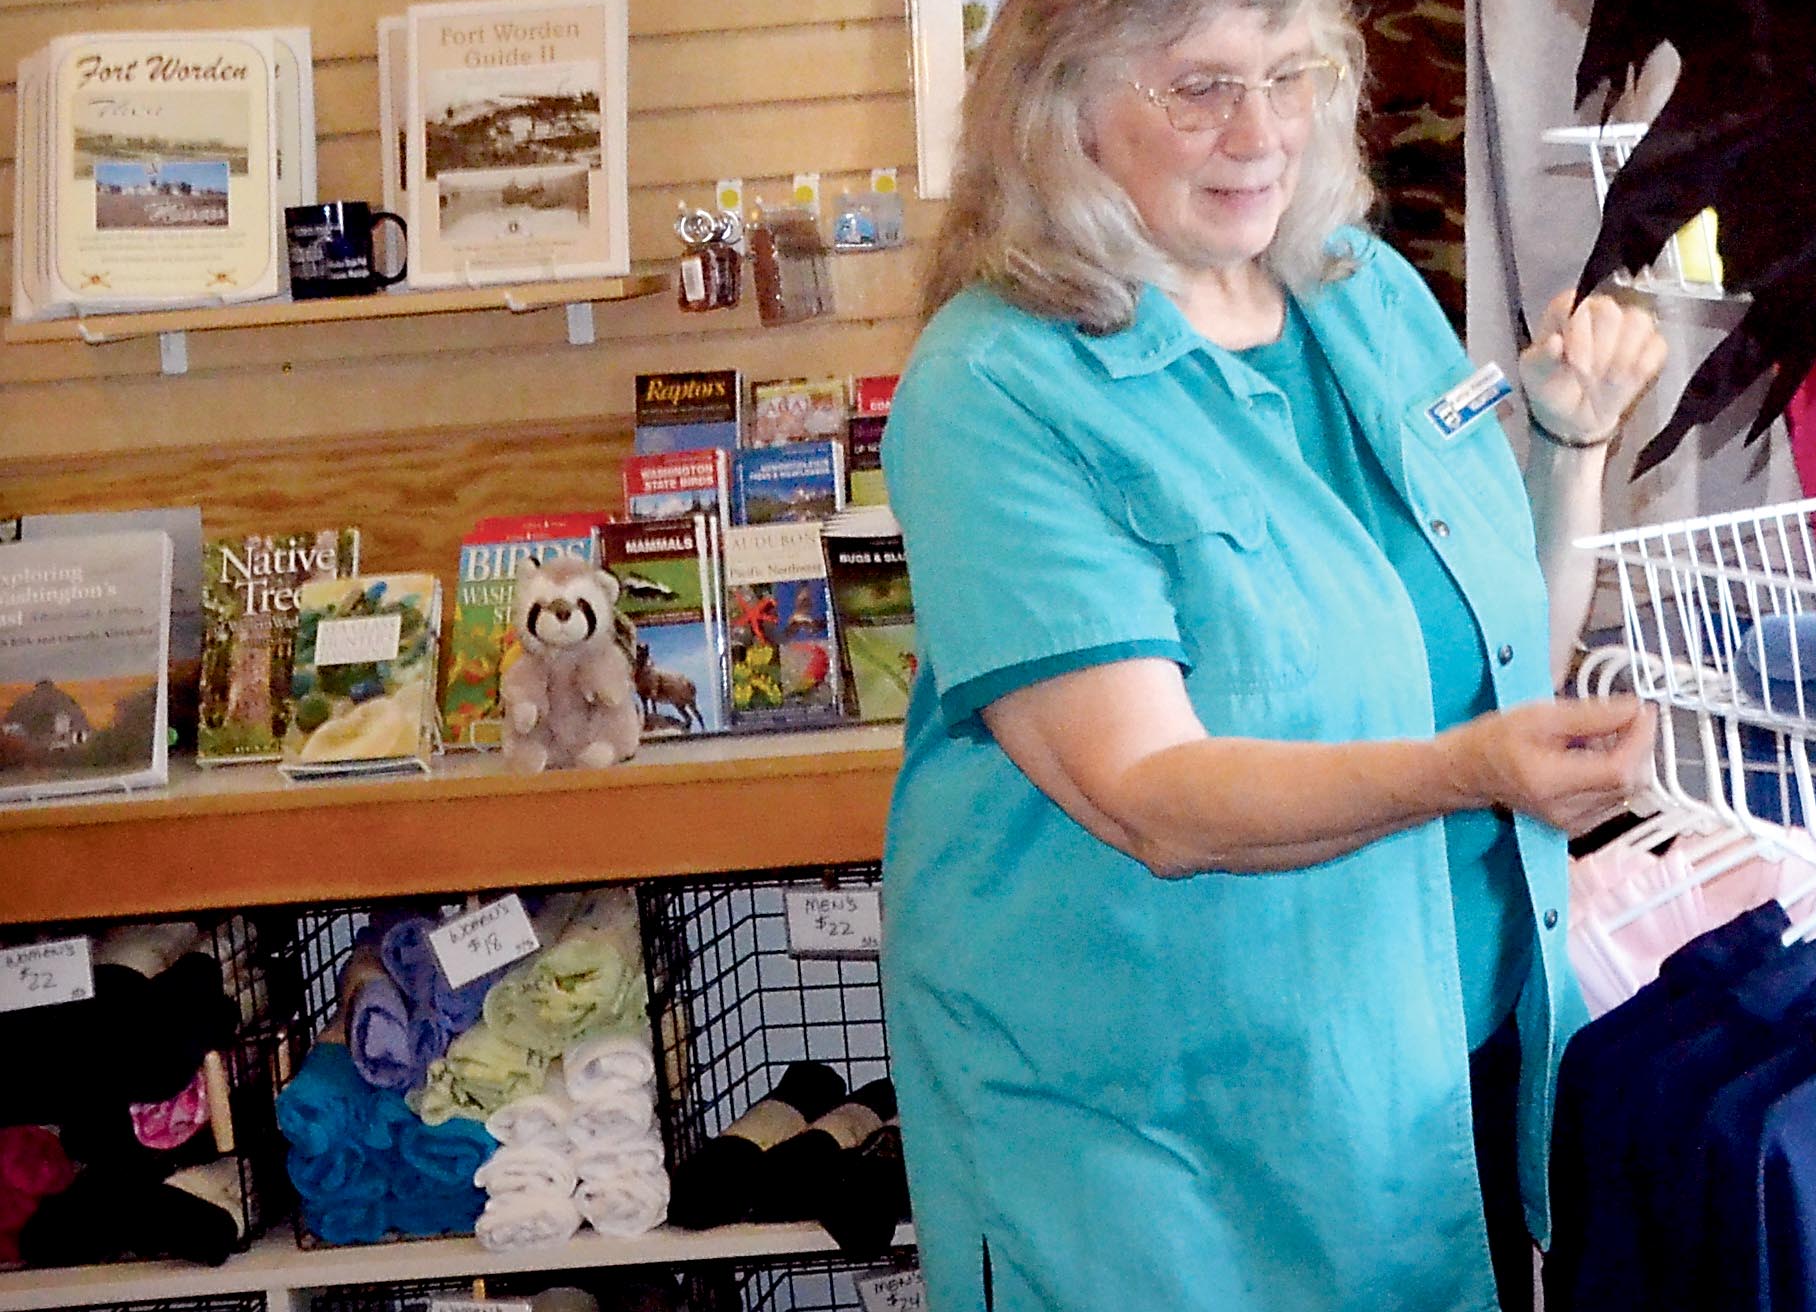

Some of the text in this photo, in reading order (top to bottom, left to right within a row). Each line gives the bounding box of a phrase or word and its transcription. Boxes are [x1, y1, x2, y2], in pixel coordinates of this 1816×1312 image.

[440, 21, 580, 46] Fort Worden
[464, 47, 532, 68] Guide
[75, 56, 248, 90] Fort Worden
[646, 376, 726, 406] Raptors
[641, 463, 714, 479] WASHINGTON
[645, 475, 714, 491] STATE BIRDS
[625, 537, 693, 554] MAMMALS
[733, 533, 817, 551] AUDUBON
[220, 538, 337, 584] Native
[839, 549, 907, 564] BUGS & SLU
[0, 563, 84, 589] xploring
[767, 562, 822, 577] Northwest
[0, 580, 118, 607] ashington's
[234, 578, 301, 617] Tre
[463, 584, 513, 607] WASH
[805, 894, 858, 915] MEN'S
[449, 902, 510, 945] WOMEN'S
[815, 914, 855, 937] $22
[4, 942, 76, 969] WOMEN'S
[468, 932, 503, 957] $18
[20, 967, 58, 992] $22
